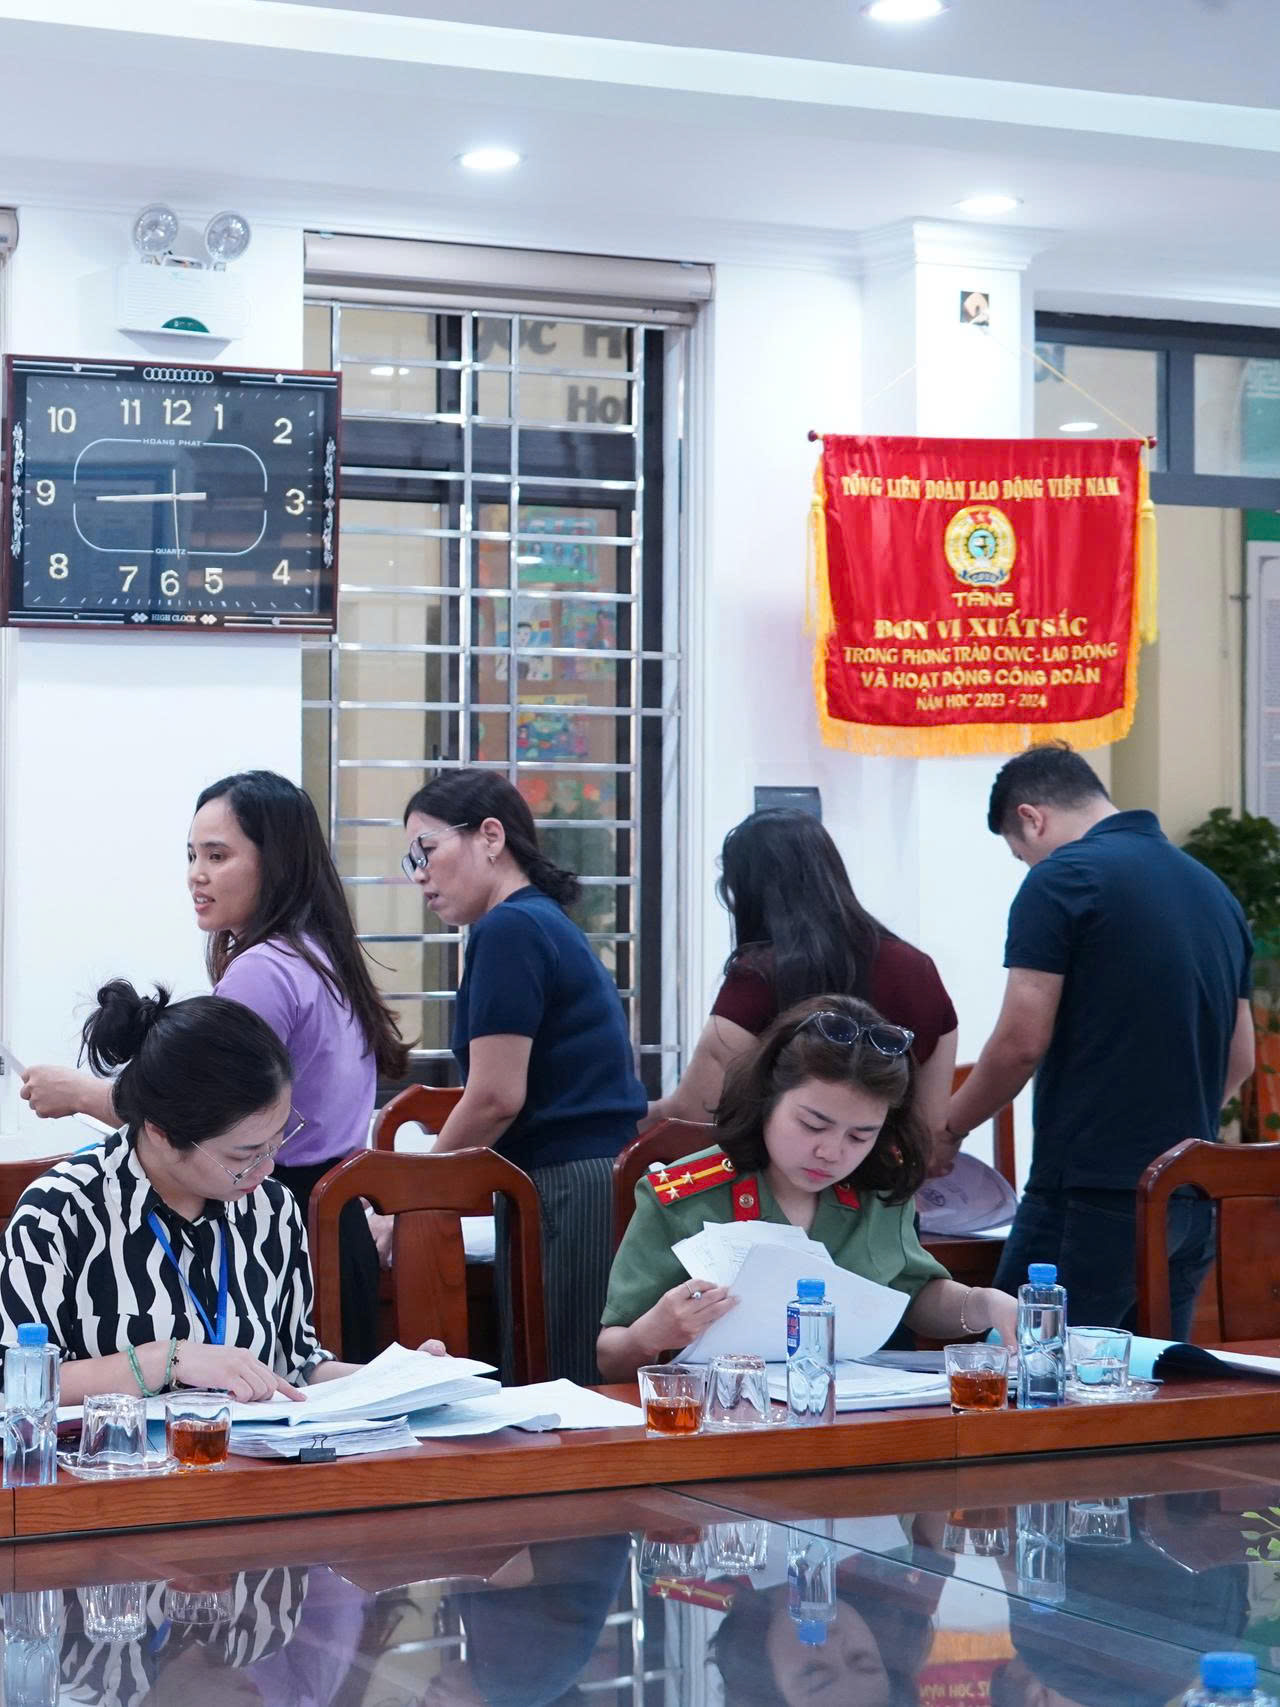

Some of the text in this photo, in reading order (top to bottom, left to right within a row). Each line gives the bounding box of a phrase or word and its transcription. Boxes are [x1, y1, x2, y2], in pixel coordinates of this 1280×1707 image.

[48, 398, 293, 445] 10 11 12 1 2
[36, 480, 305, 516] 9 3
[886, 475, 920, 499] LIÊN
[925, 476, 965, 500] ĐOÀN
[969, 480, 999, 500] LAO
[1002, 475, 1043, 502] ĐỘNG
[1047, 474, 1081, 500] VIỆT
[1086, 476, 1120, 497] NAM
[49, 553, 291, 596] 8 7 6 5 4
[874, 608, 1088, 642] ĐƠN VỊ XUẤT SẮC
[842, 646, 898, 663] TRONG
[902, 647, 951, 664] PHONG
[952, 641, 991, 663] TRÀO
[1071, 641, 1118, 663] ĐỘNG
[861, 663, 1100, 693] VÀ HOẠT ĐỘNG CÔNG ĐOÀN
